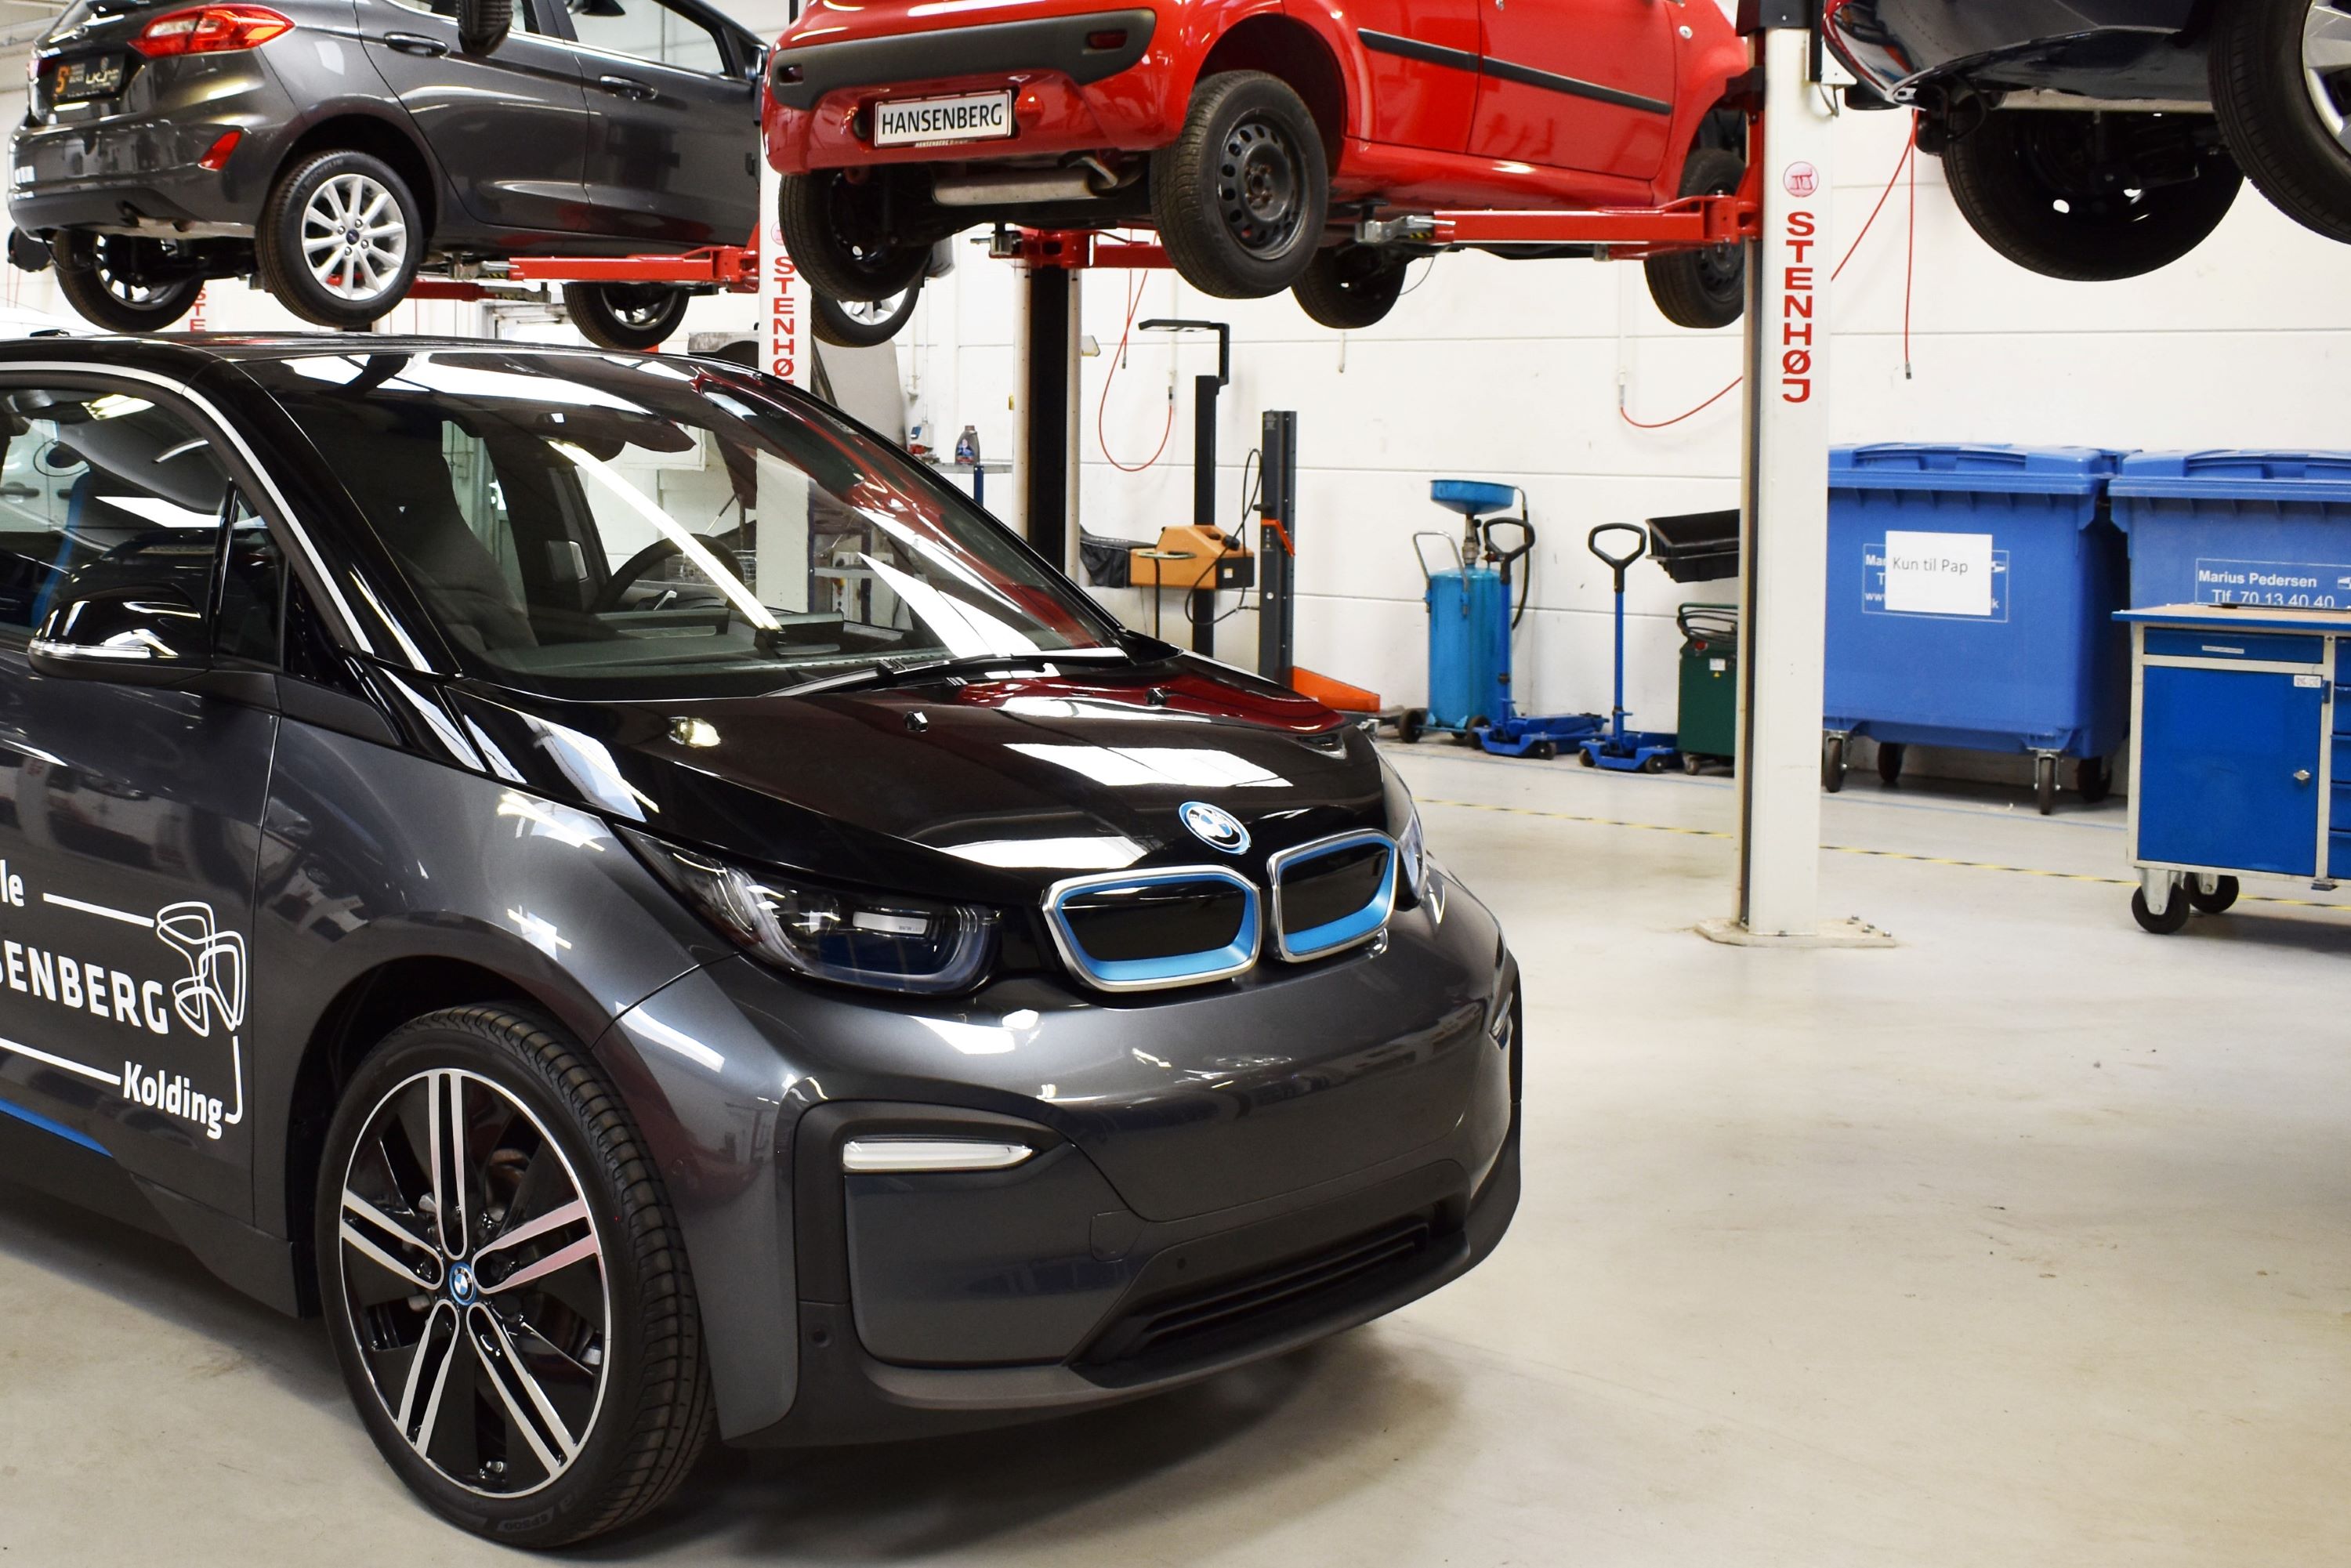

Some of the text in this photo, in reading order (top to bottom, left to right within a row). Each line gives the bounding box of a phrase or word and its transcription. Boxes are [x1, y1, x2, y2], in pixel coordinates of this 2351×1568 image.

[882, 103, 1002, 135] HANSENBERG
[773, 256, 795, 385] STENHØ
[1782, 212, 1816, 403] STENHØJ
[1893, 556, 1969, 576] Kun til Pap
[2198, 570, 2317, 588] Marius Pedersen
[2240, 591, 2259, 604] 70
[2288, 594, 2309, 607] 40
[2313, 596, 2335, 608] 40
[0, 940, 168, 1034] ENBERG
[123, 1060, 223, 1140] Kolding
